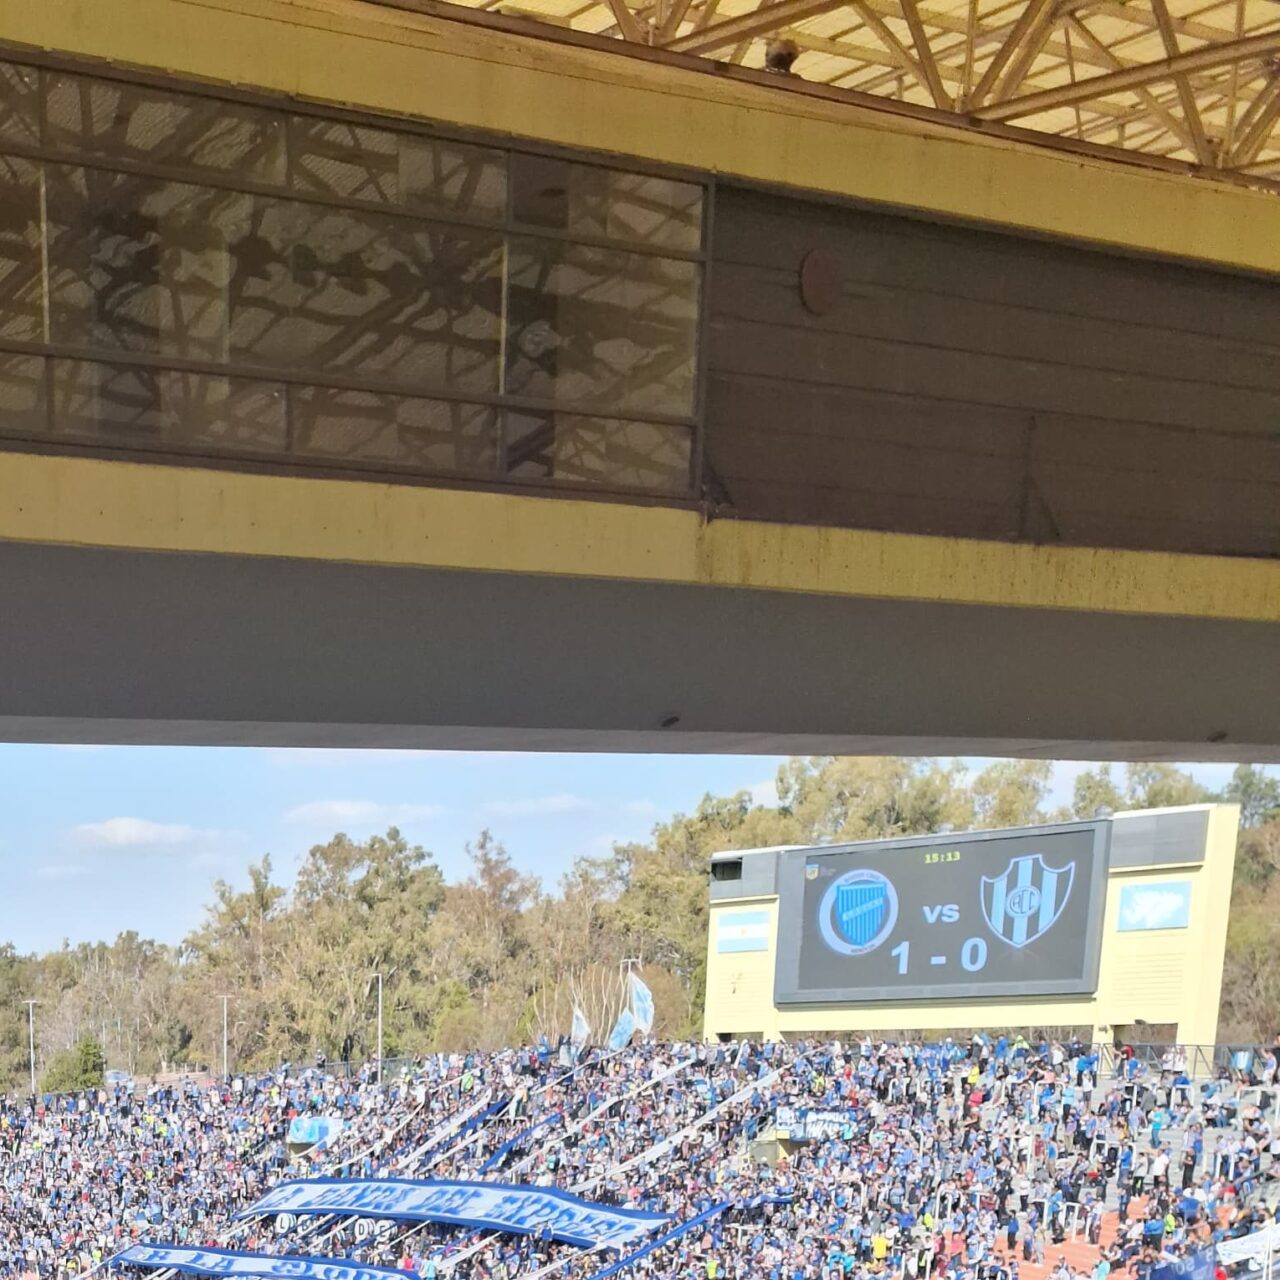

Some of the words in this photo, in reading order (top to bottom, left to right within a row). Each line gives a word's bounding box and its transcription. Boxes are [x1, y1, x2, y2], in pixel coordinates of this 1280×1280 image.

[925, 851, 961, 864] 15:13
[891, 941, 911, 975] 1
[961, 937, 988, 972] 0
